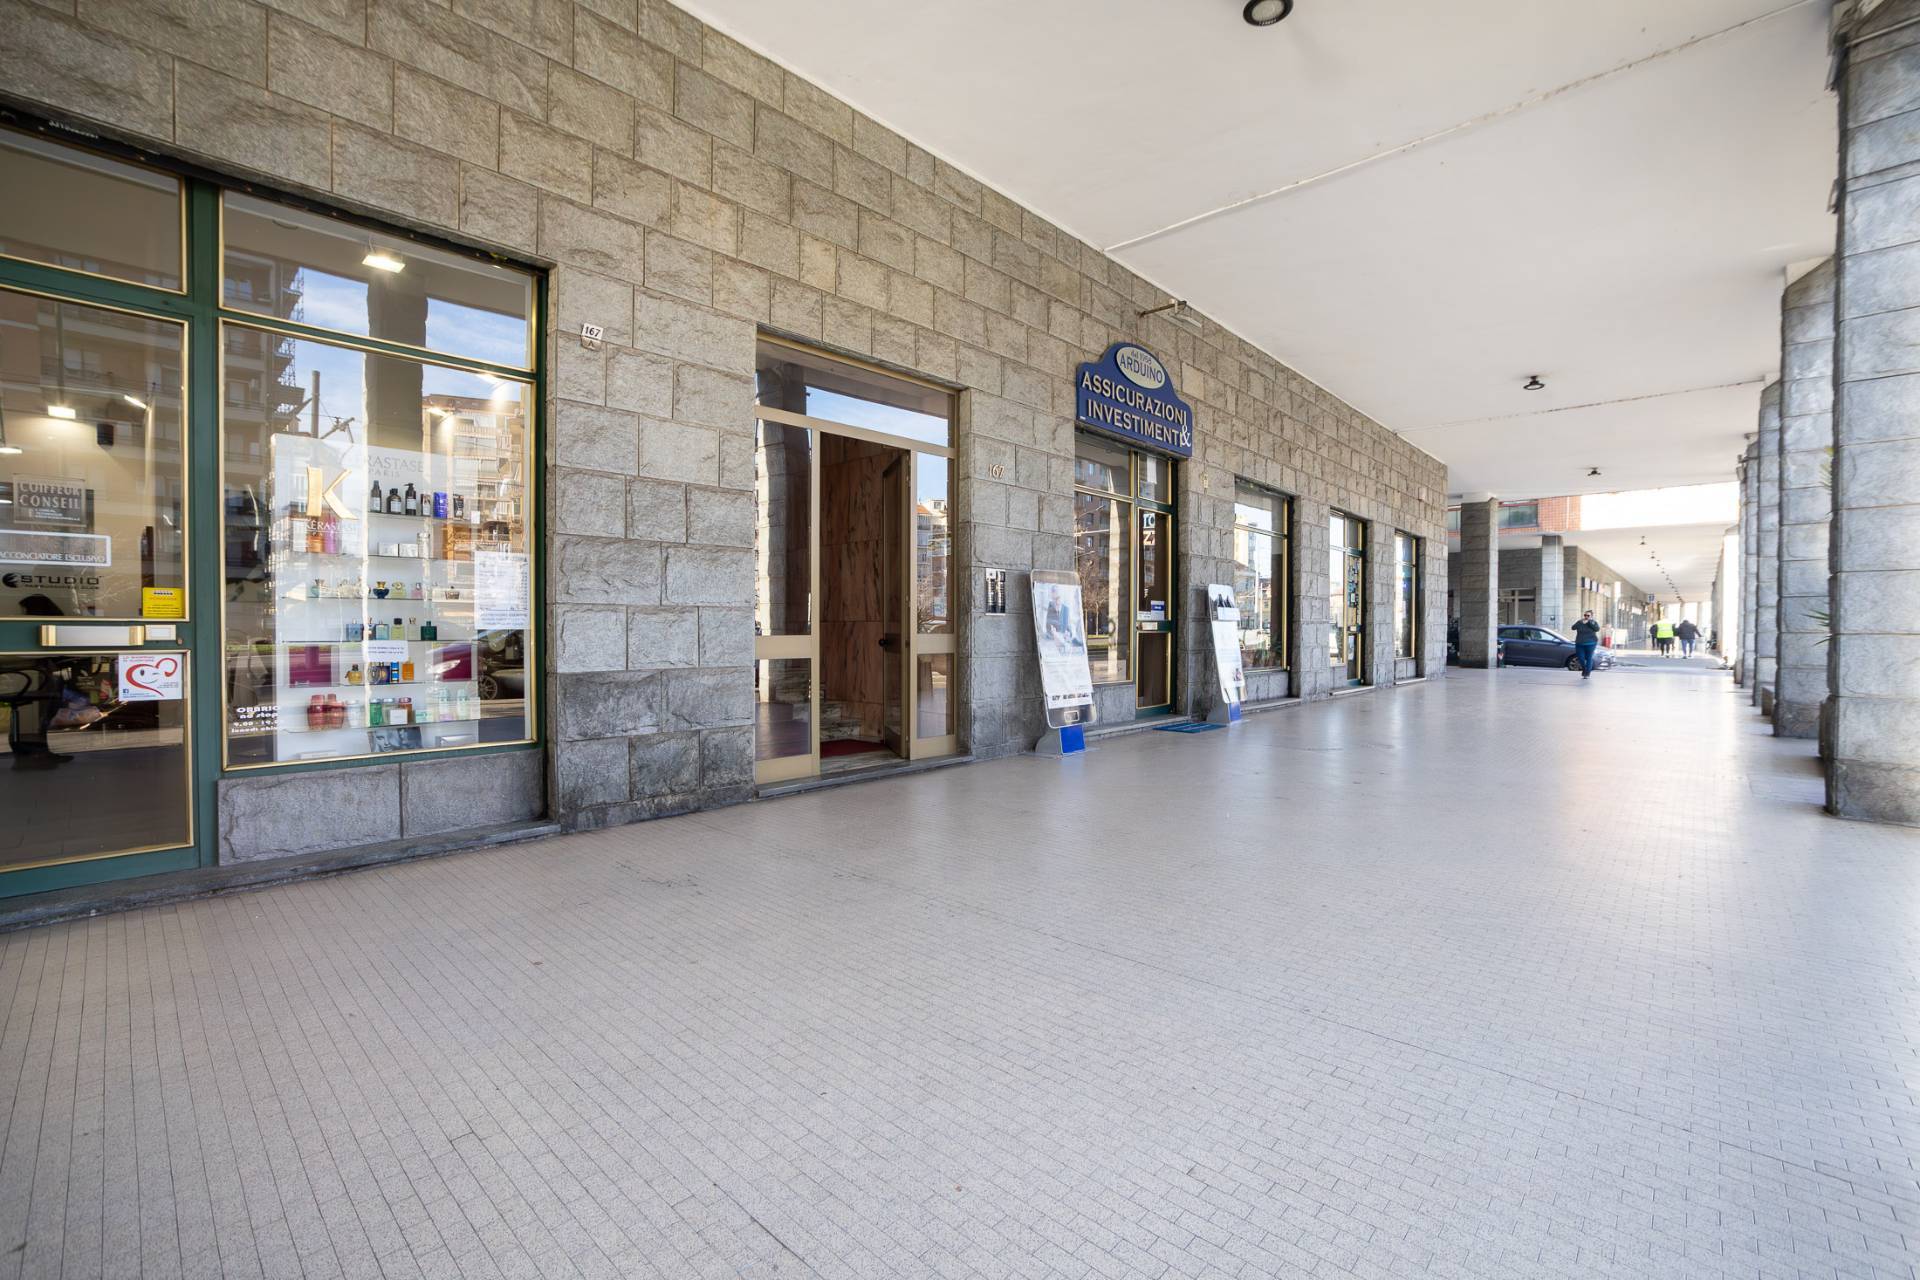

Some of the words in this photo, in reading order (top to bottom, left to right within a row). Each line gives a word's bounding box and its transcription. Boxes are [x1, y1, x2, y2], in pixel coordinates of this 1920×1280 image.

[585, 326, 601, 337] 167
[1120, 352, 1163, 384] ARDUINO
[1082, 371, 1187, 426] ASSICURAZIONI
[1088, 399, 1183, 448] INVESTIMENTI
[1181, 424, 1192, 447] &
[988, 464, 1005, 478] 167
[305, 464, 359, 520] K
[20, 494, 81, 510] CONSEIL
[21, 575, 100, 585] STUDIO
[236, 705, 281, 714] ORARIO
[256, 712, 279, 720] stop
